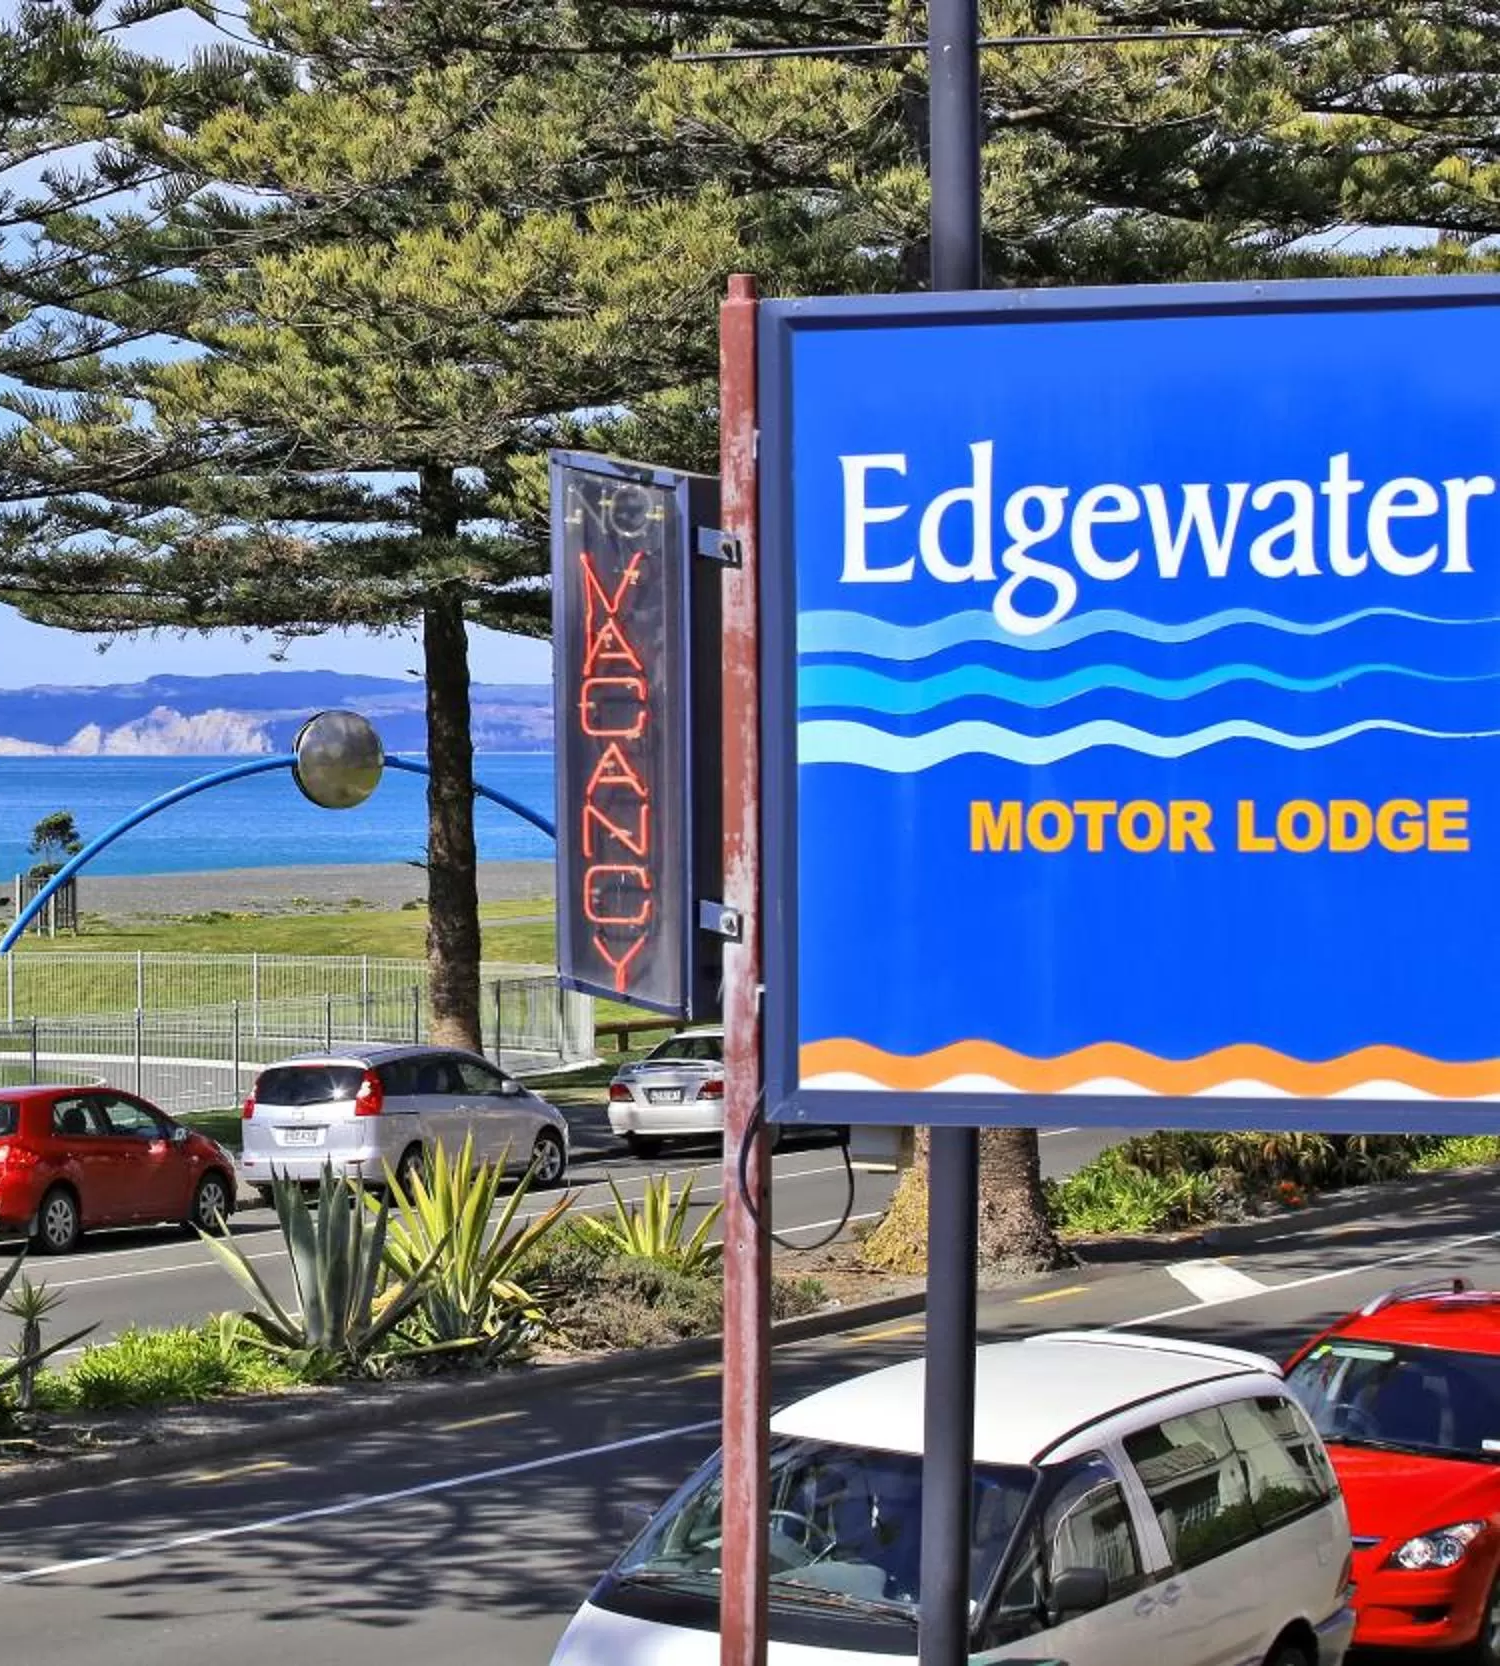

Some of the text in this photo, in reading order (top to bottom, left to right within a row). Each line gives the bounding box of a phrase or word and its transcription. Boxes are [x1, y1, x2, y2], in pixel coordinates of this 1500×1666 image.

[566, 484, 653, 538] NO
[838, 440, 1496, 635] Edgewater
[579, 551, 651, 992] VACANCY
[970, 800, 1470, 853] MOTOR LODGE
